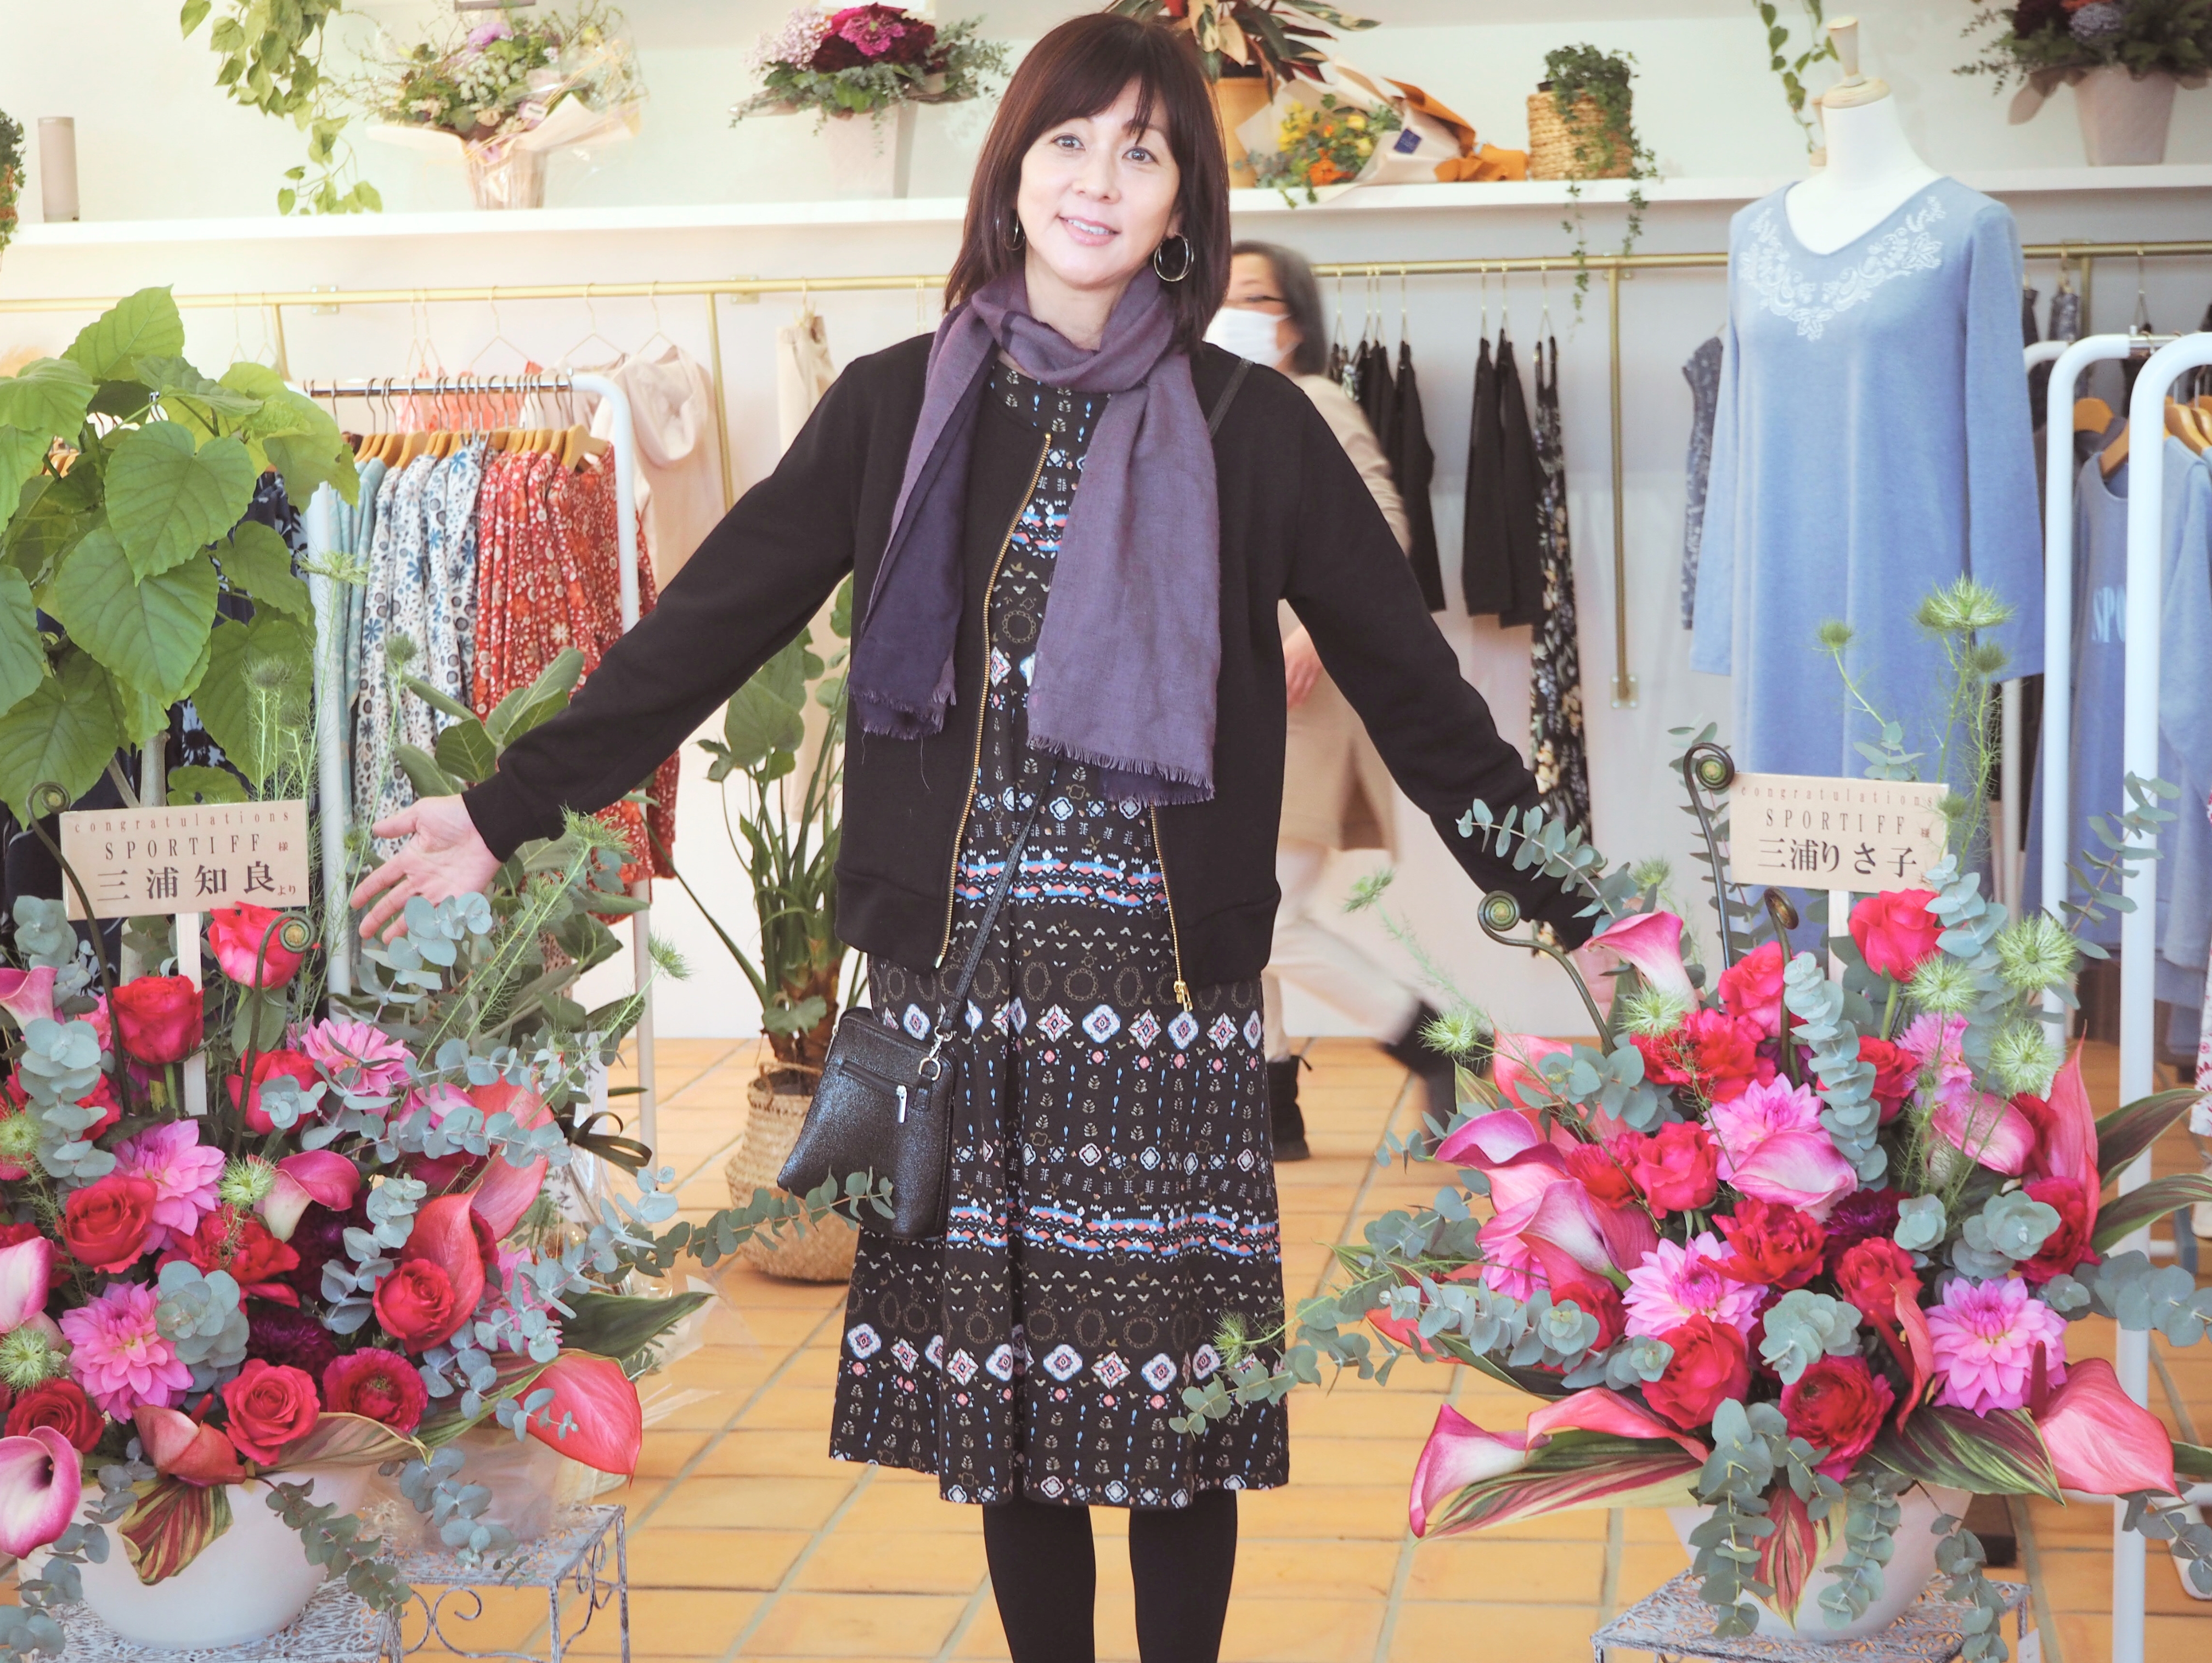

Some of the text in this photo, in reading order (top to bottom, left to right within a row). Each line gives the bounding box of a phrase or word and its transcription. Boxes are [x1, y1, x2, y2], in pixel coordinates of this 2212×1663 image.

[1741, 786, 1933, 807] congratulations
[75, 811, 289, 833] congratulations
[1765, 808, 1905, 835] SPORTIFF
[105, 834, 260, 860] SPORTIFF
